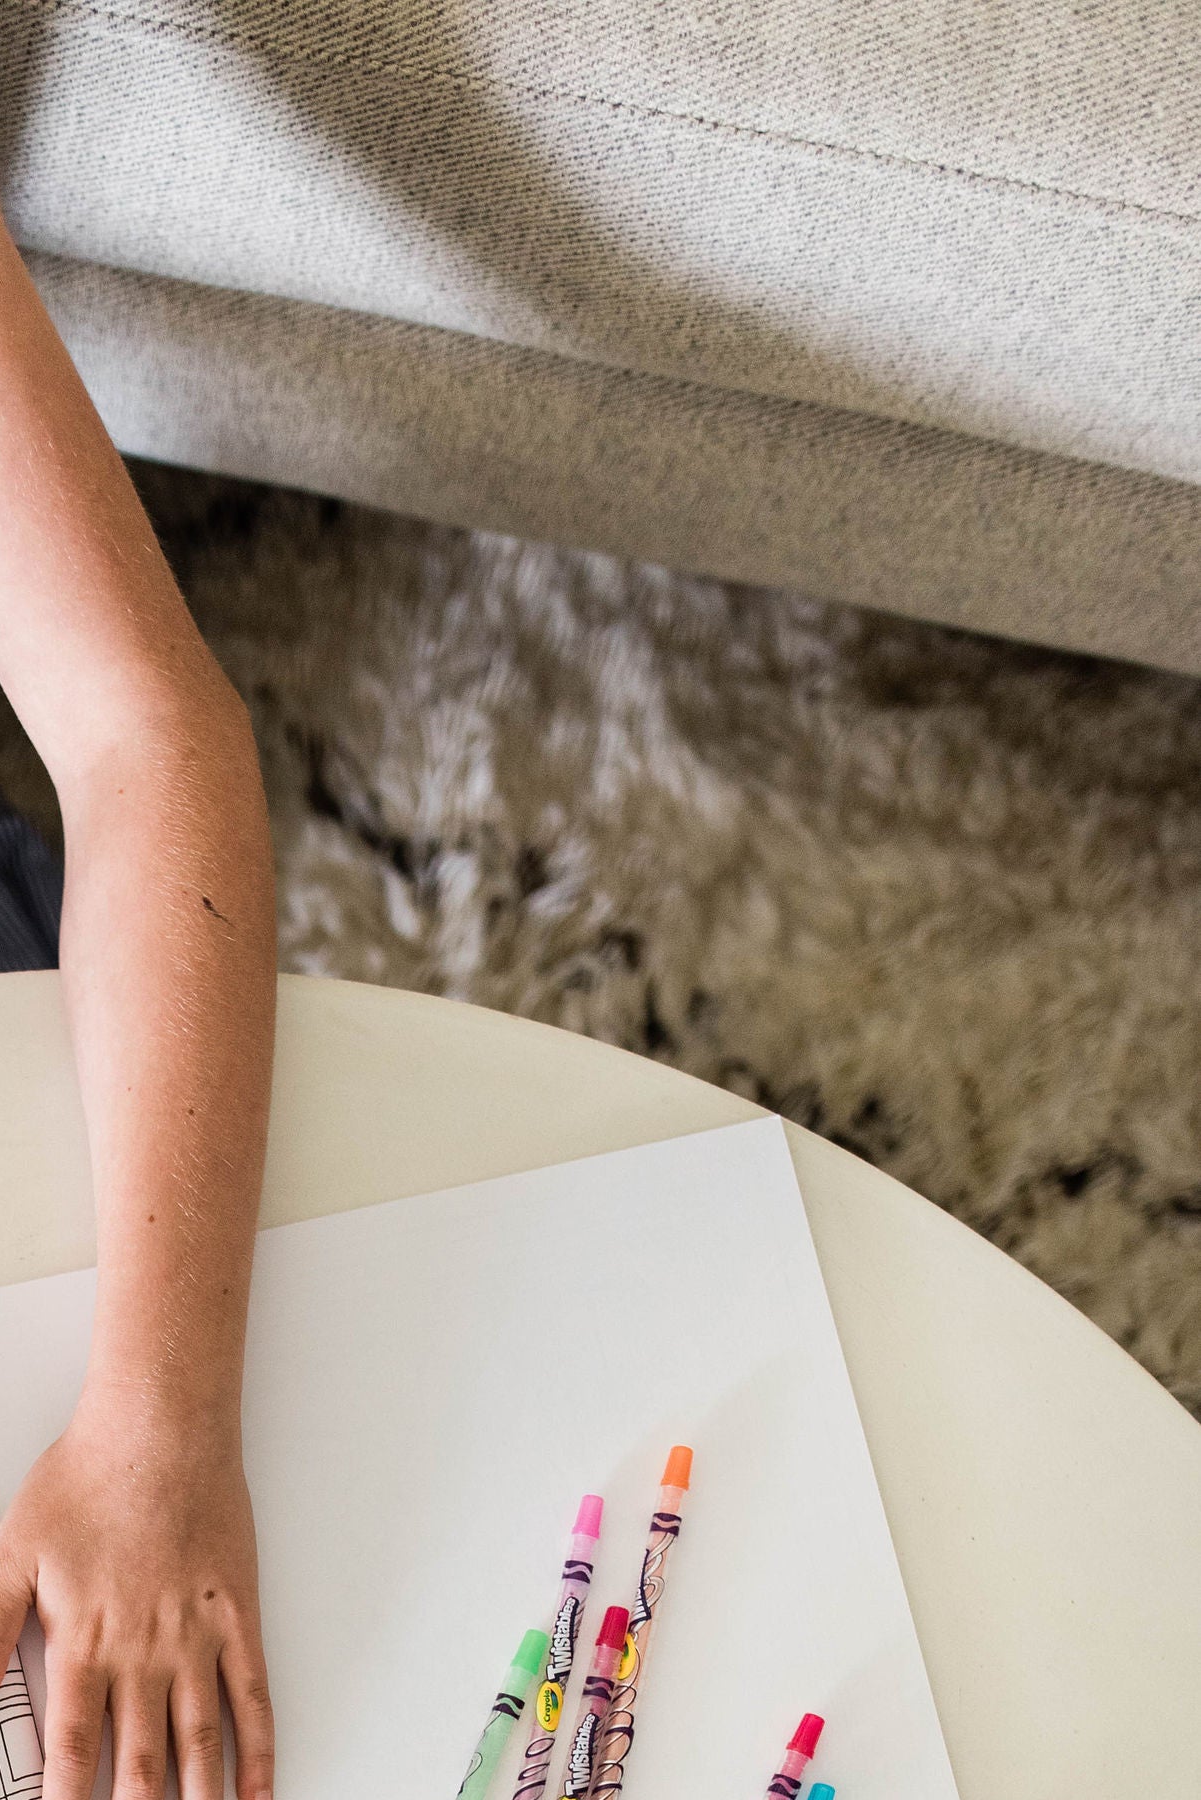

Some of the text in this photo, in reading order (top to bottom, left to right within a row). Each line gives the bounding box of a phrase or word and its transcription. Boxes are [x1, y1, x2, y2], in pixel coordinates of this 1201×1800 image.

[542, 1596, 576, 1723] Crayola Twistables
[564, 1713, 596, 1797] Twistables
